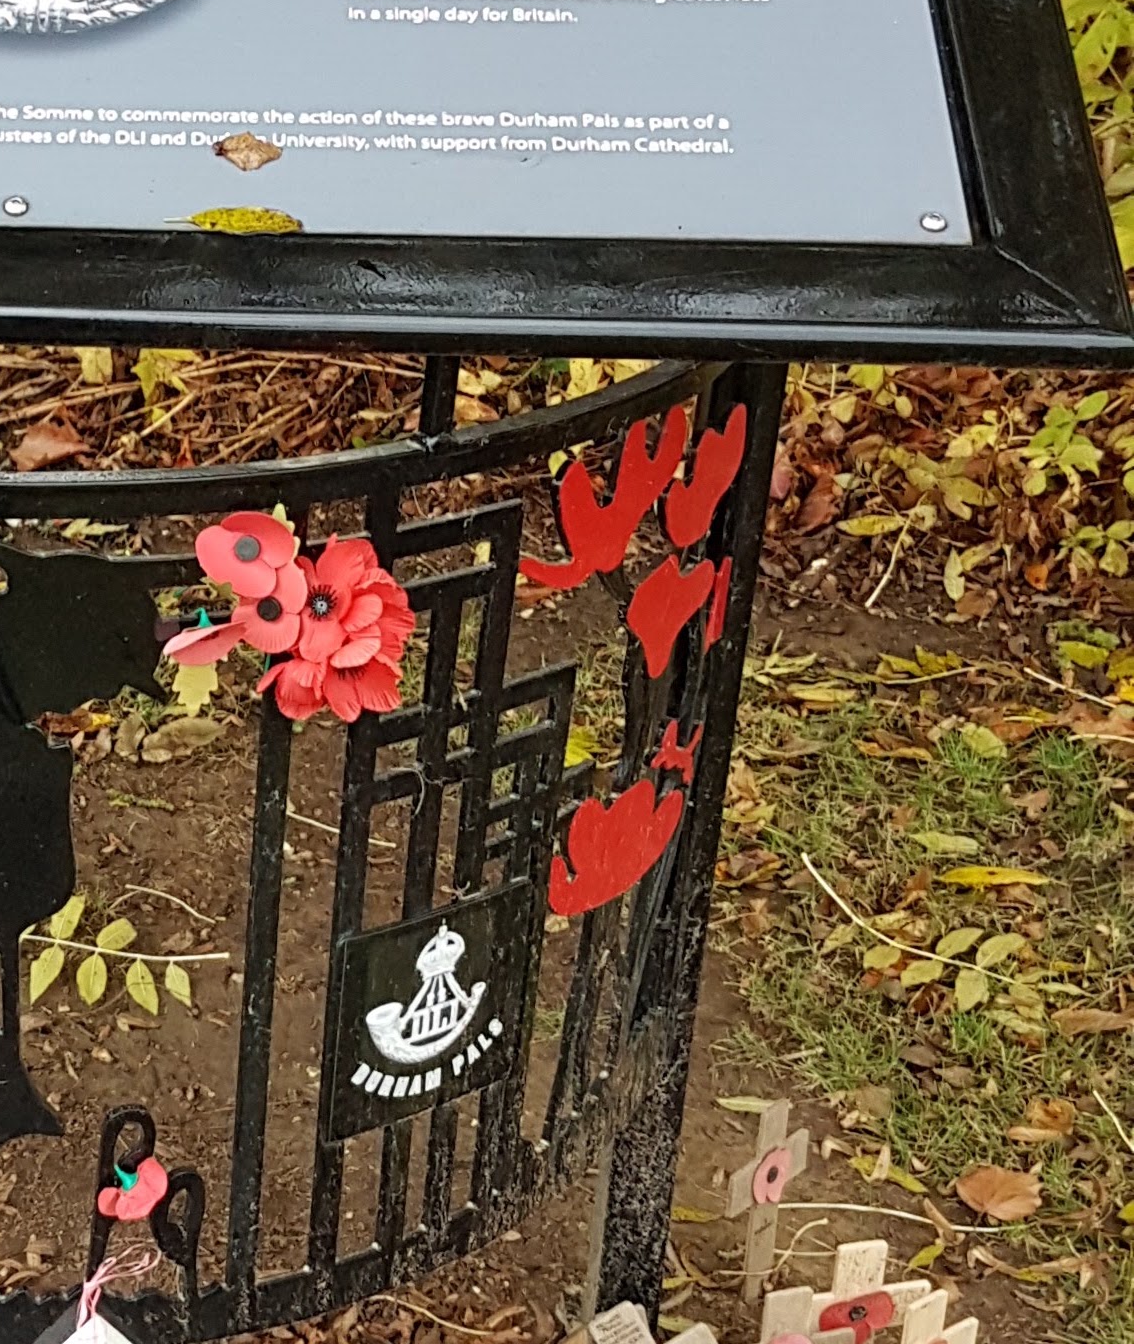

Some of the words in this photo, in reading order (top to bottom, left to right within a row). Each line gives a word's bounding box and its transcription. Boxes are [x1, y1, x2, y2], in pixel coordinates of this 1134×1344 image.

[23, 105, 94, 121] Somme
[97, 108, 118, 122] to
[121, 110, 259, 123] commemorate
[262, 109, 295, 124] the
[299, 110, 358, 124] action
[361, 110, 382, 125] of
[385, 111, 437, 126] these
[441, 111, 495, 126] brave
[499, 112, 578, 127] Durham
[582, 113, 620, 128] Pals
[624, 116, 645, 128] as
[649, 116, 689, 132] part
[693, 114, 714, 130] of
[718, 118, 730, 130] a
[350, 1062, 442, 1098] DURHAM
[452, 1017, 504, 1076] PALS
